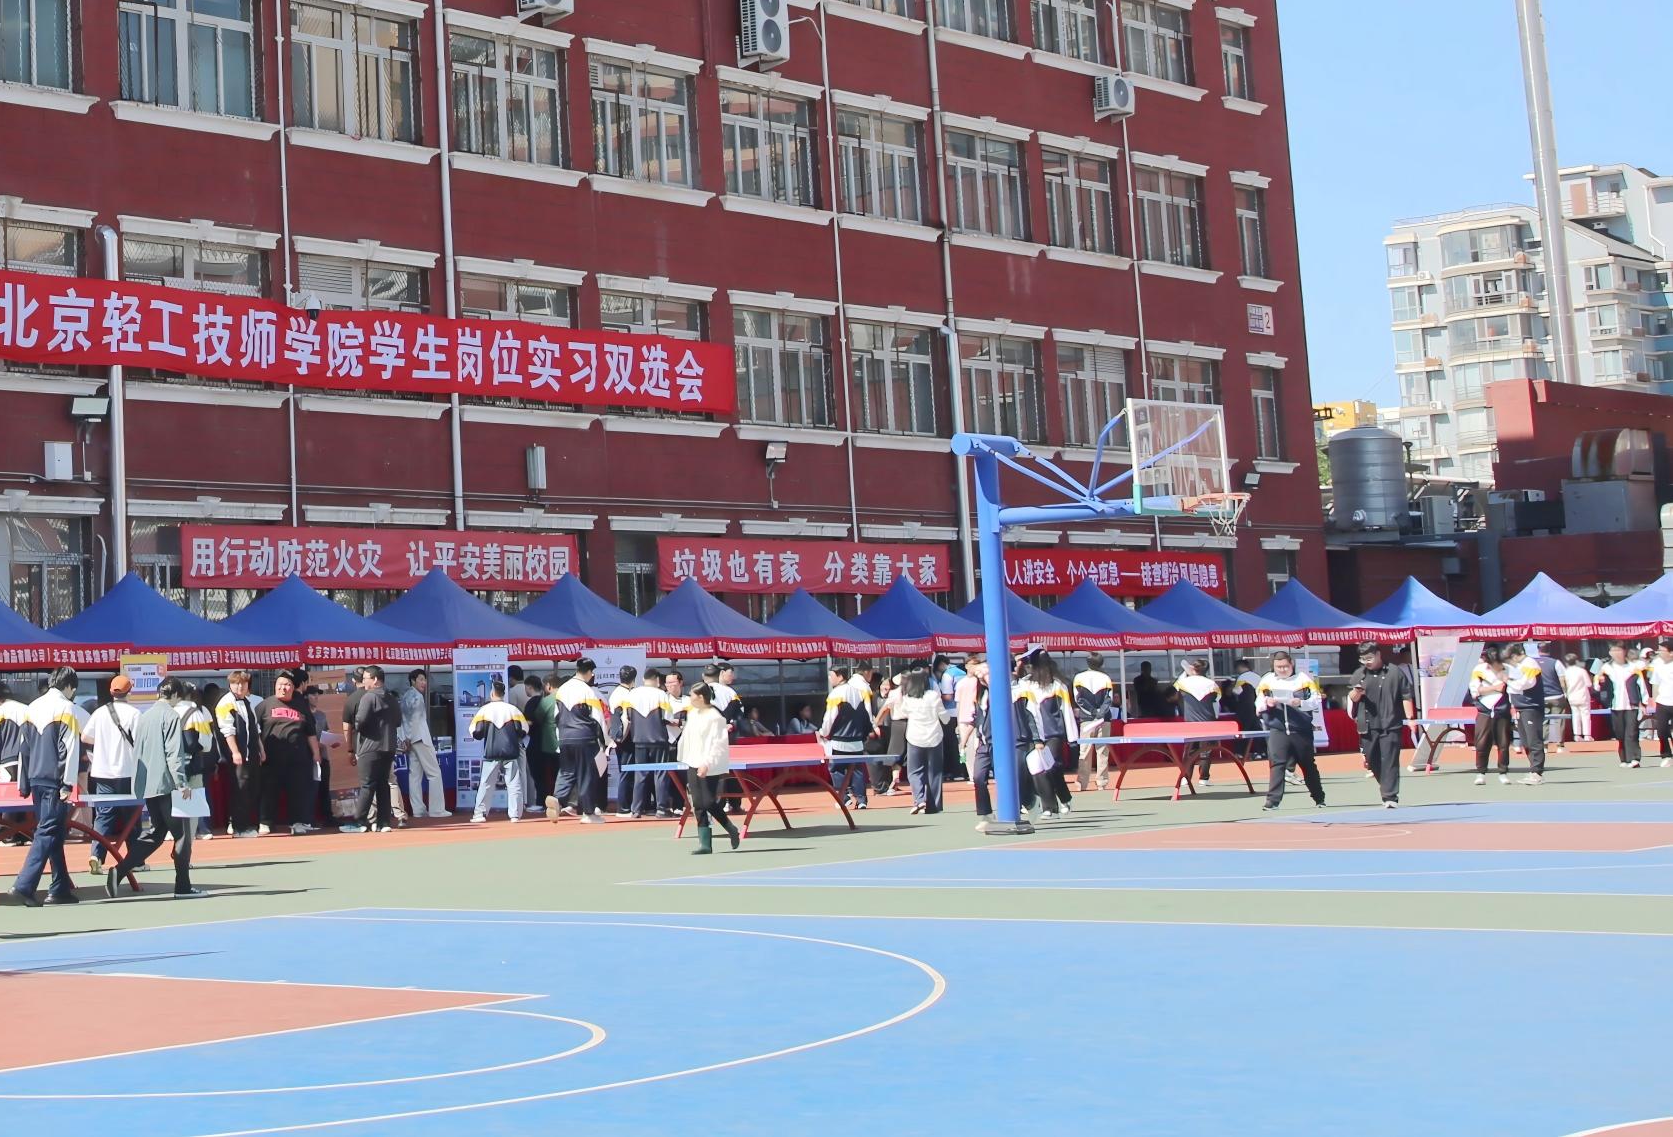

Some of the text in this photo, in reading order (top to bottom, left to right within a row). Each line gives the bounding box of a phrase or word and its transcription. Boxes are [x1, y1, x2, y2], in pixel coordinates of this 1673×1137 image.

[190, 536, 570, 582] 用行动防范火灾 让平安美丽校园
[672, 547, 938, 586] 垃圾也有家 分类靠大家
